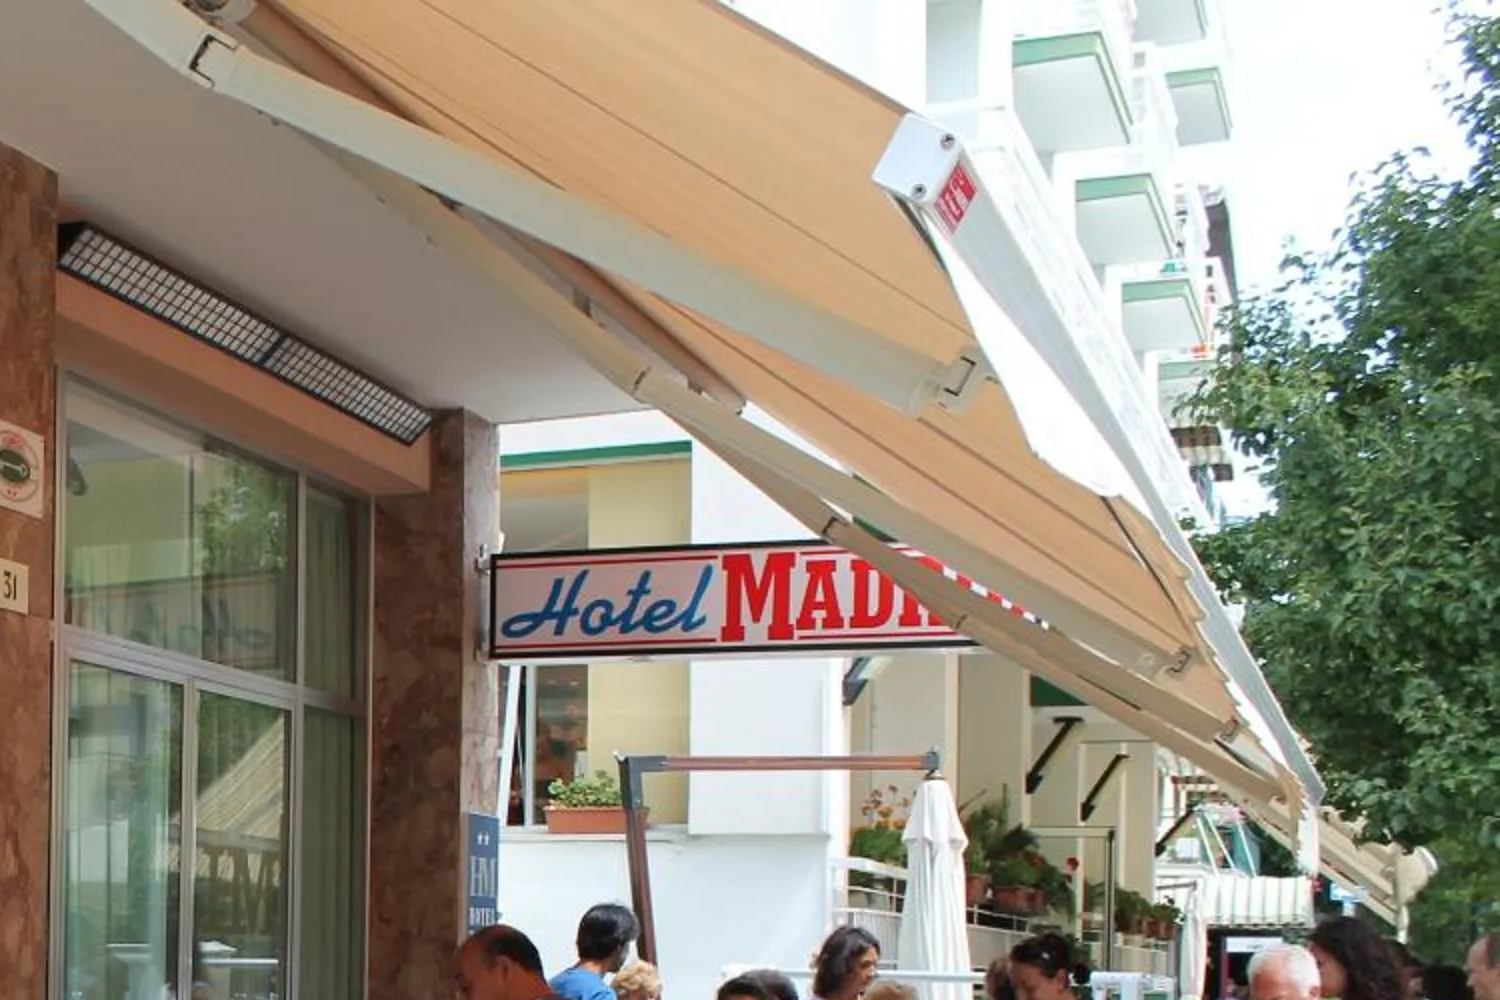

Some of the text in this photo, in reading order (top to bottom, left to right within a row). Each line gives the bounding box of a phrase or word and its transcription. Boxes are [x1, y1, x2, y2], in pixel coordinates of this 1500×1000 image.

[3, 569, 17, 600] 31
[502, 551, 948, 642] Hotel MAD
